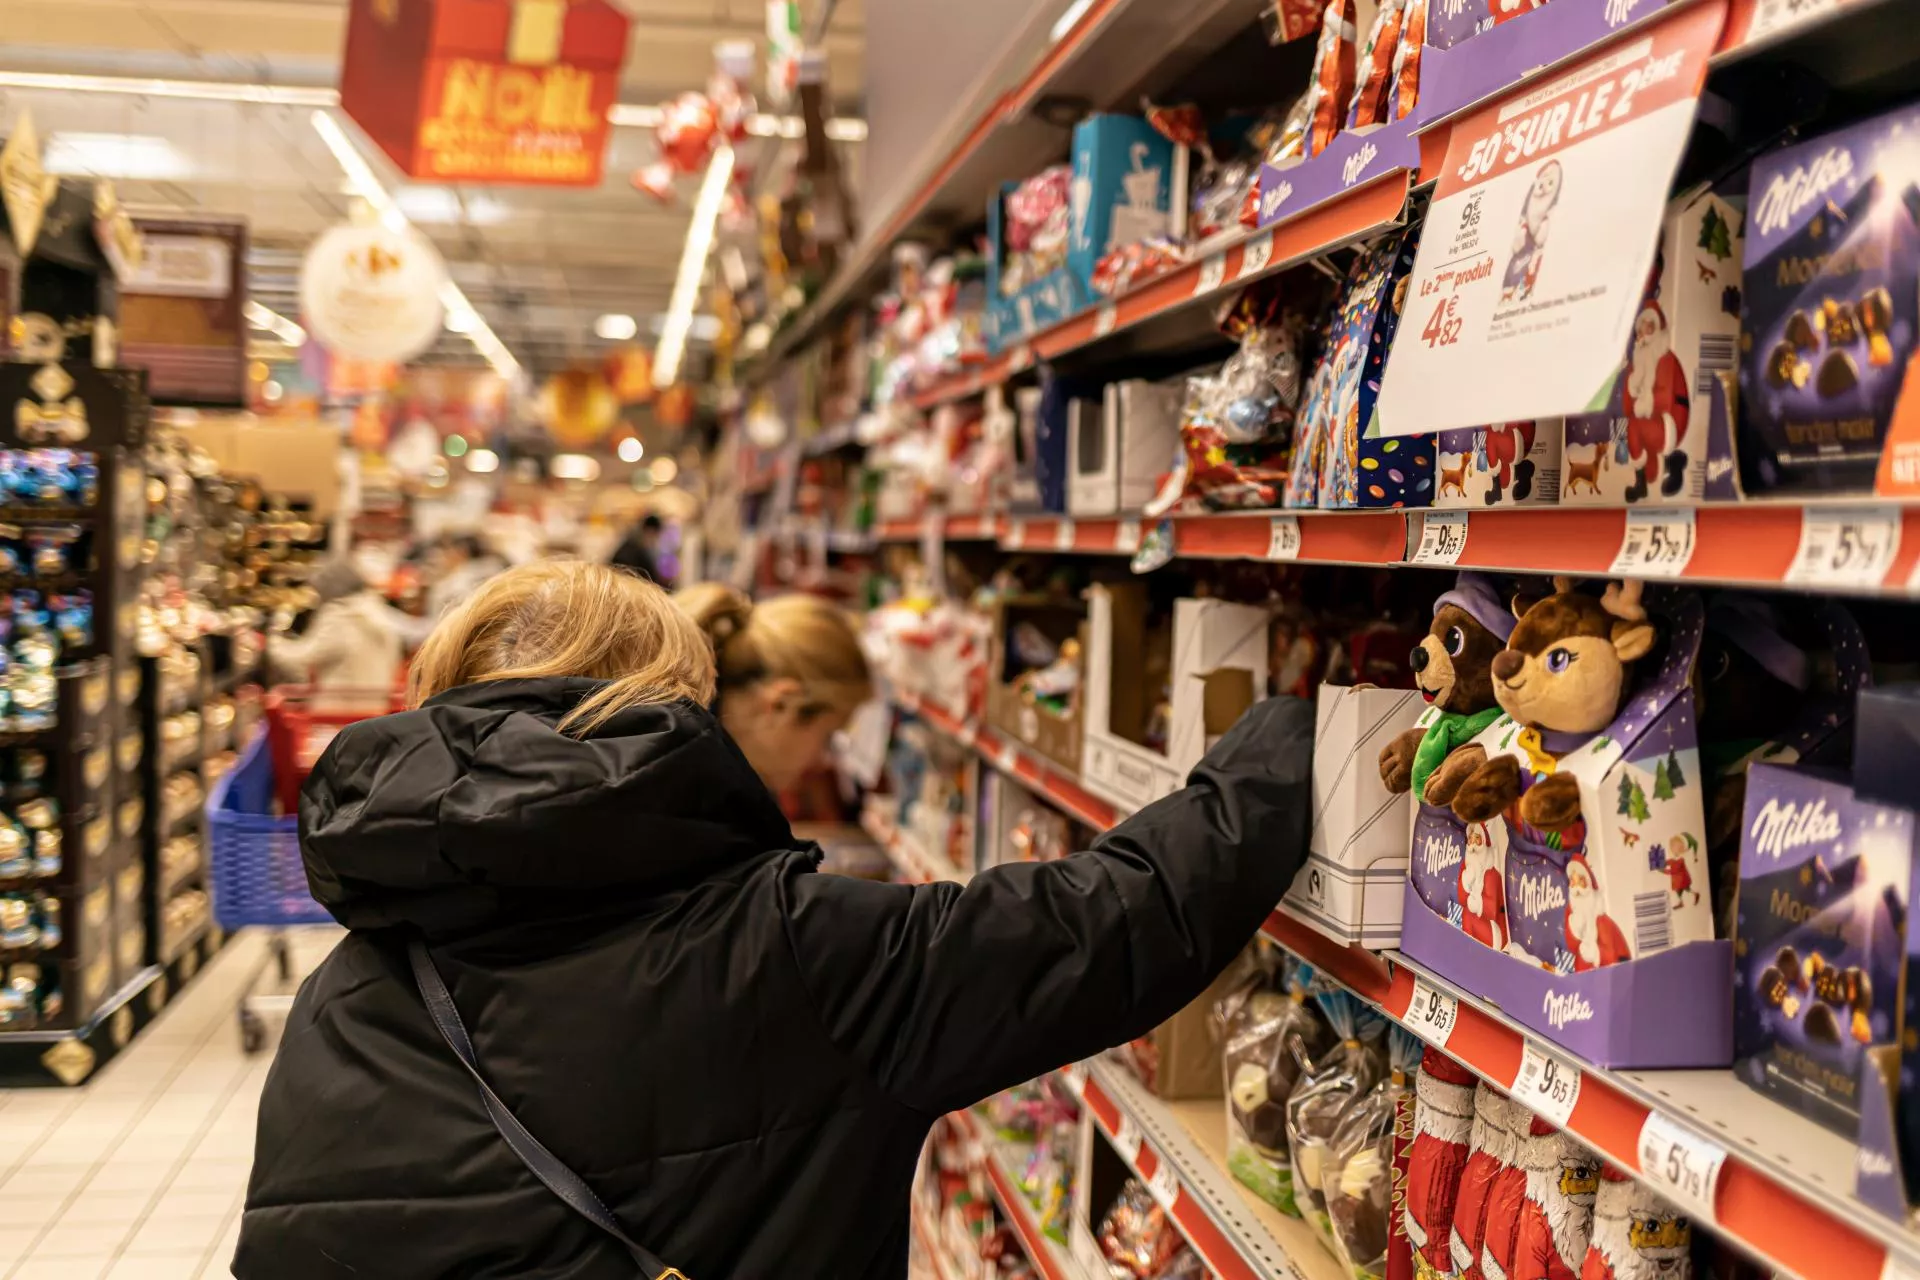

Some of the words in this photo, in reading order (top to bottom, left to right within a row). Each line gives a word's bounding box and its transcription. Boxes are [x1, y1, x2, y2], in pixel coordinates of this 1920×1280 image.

[1504, 103, 1570, 165] SUR
[1568, 80, 1614, 139] LE
[1342, 141, 1378, 187] Milka
[1262, 180, 1293, 219] Milka
[1754, 146, 1854, 236] Milka
[1420, 278, 1433, 297] Le
[1453, 256, 1494, 292] produit
[1750, 797, 1842, 860] Milka
[1424, 834, 1462, 877] Milka
[1519, 873, 1566, 920] Milka
[1543, 990, 1594, 1030] Milka
